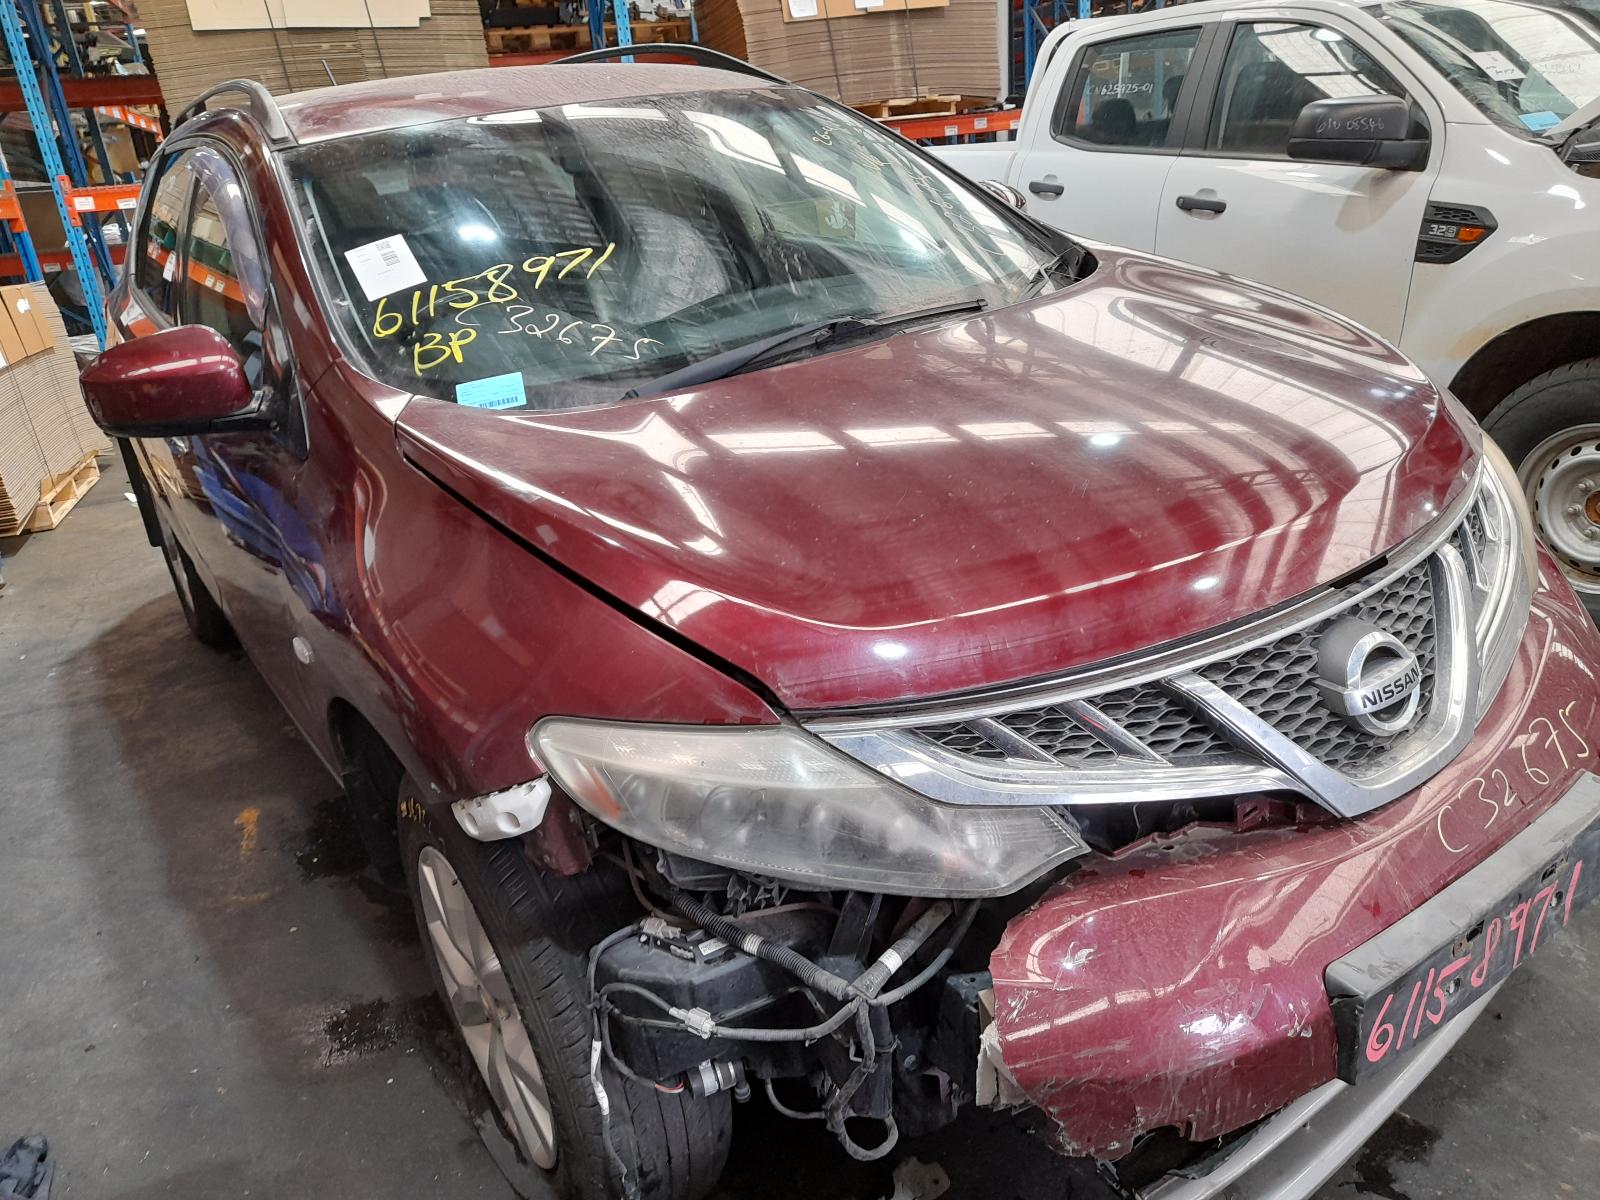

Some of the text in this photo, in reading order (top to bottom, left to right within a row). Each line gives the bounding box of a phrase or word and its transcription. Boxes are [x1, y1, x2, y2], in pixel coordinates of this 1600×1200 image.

[373, 243, 616, 338] 61158971
[413, 328, 477, 376] BP
[1361, 663, 1420, 709] NISSAN
[1437, 700, 1590, 853] C32675
